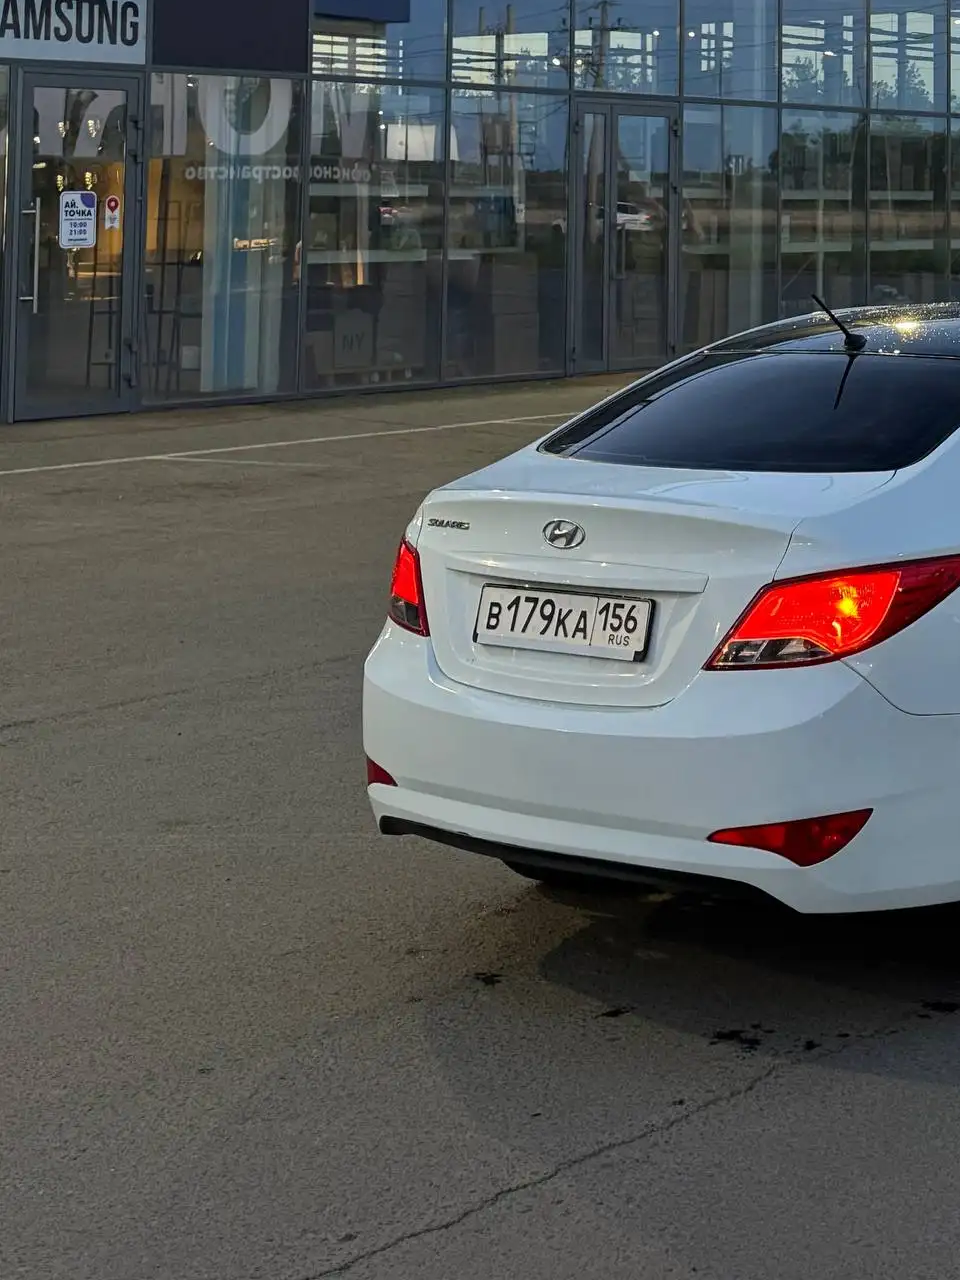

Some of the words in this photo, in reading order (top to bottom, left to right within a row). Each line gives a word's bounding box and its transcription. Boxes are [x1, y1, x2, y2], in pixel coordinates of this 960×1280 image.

[64, 209, 92, 217] ТОЧКА
[486, 596, 588, 640] В179КА
[598, 602, 638, 634] 156
[608, 634, 630, 647] RUS
